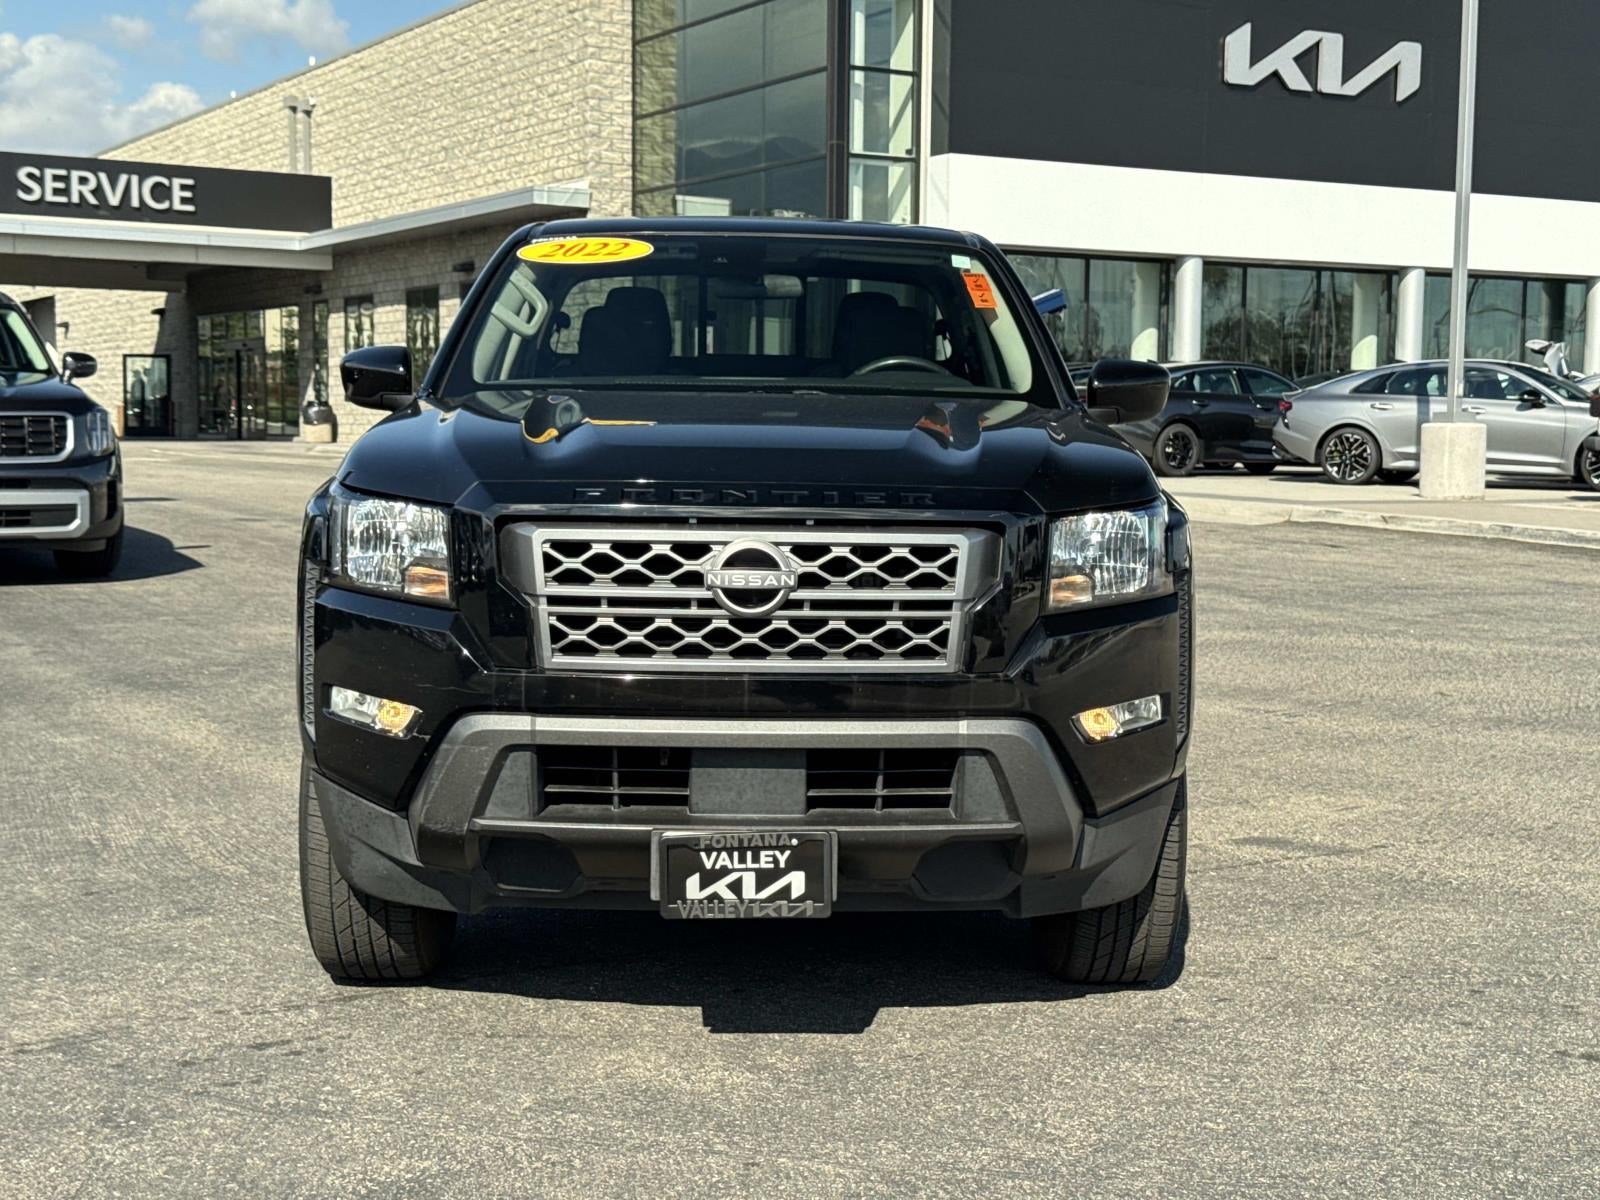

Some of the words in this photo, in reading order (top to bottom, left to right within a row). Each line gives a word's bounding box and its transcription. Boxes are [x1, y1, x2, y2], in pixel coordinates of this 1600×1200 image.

[1224, 22, 1422, 102] KIA
[16, 166, 196, 212] SERVICE
[538, 242, 630, 258] 2022
[574, 487, 934, 505] FRONTIER
[707, 573, 795, 586] NISSAN
[701, 833, 791, 848] FONTANA
[700, 850, 791, 869] VALLEY
[686, 871, 805, 899] KIA
[677, 899, 749, 919] VALLEY
[753, 900, 814, 917] KIA
